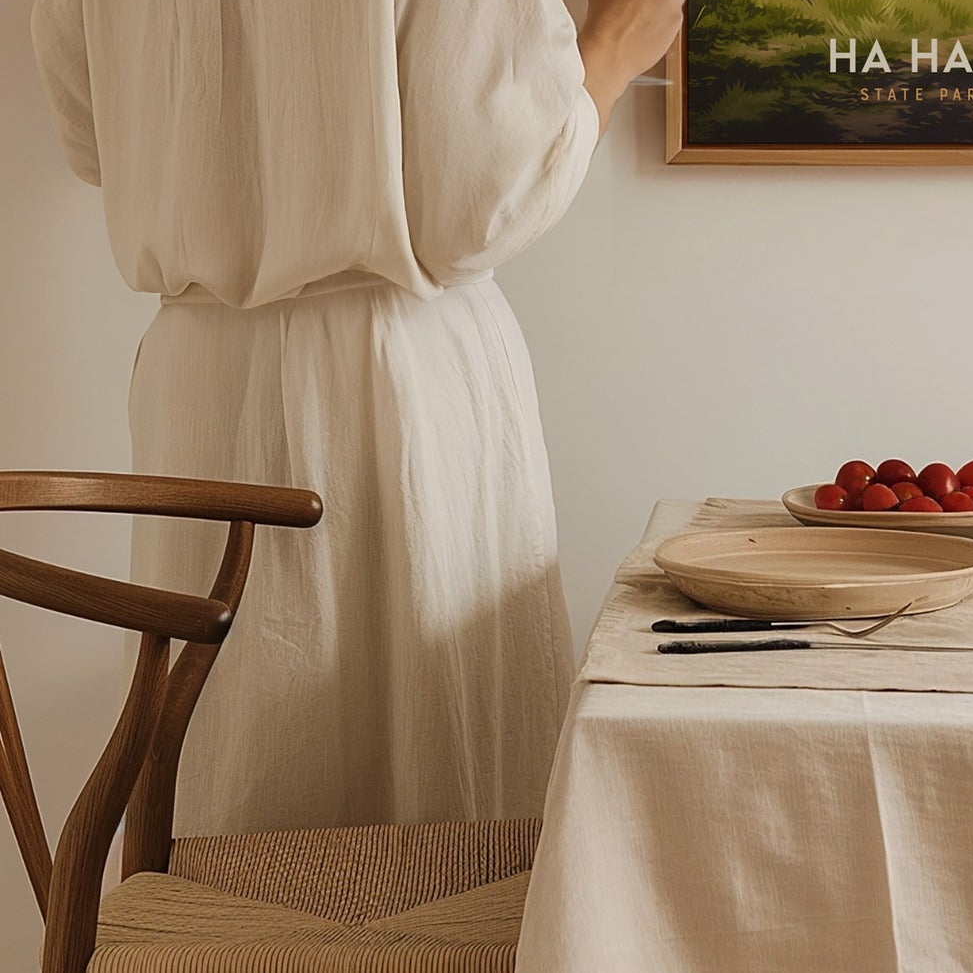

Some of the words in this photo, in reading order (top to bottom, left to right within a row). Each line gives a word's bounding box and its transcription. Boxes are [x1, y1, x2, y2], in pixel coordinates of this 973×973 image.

[829, 38, 892, 73] HA
[911, 38, 973, 73] HA
[860, 87, 924, 101] STATE
